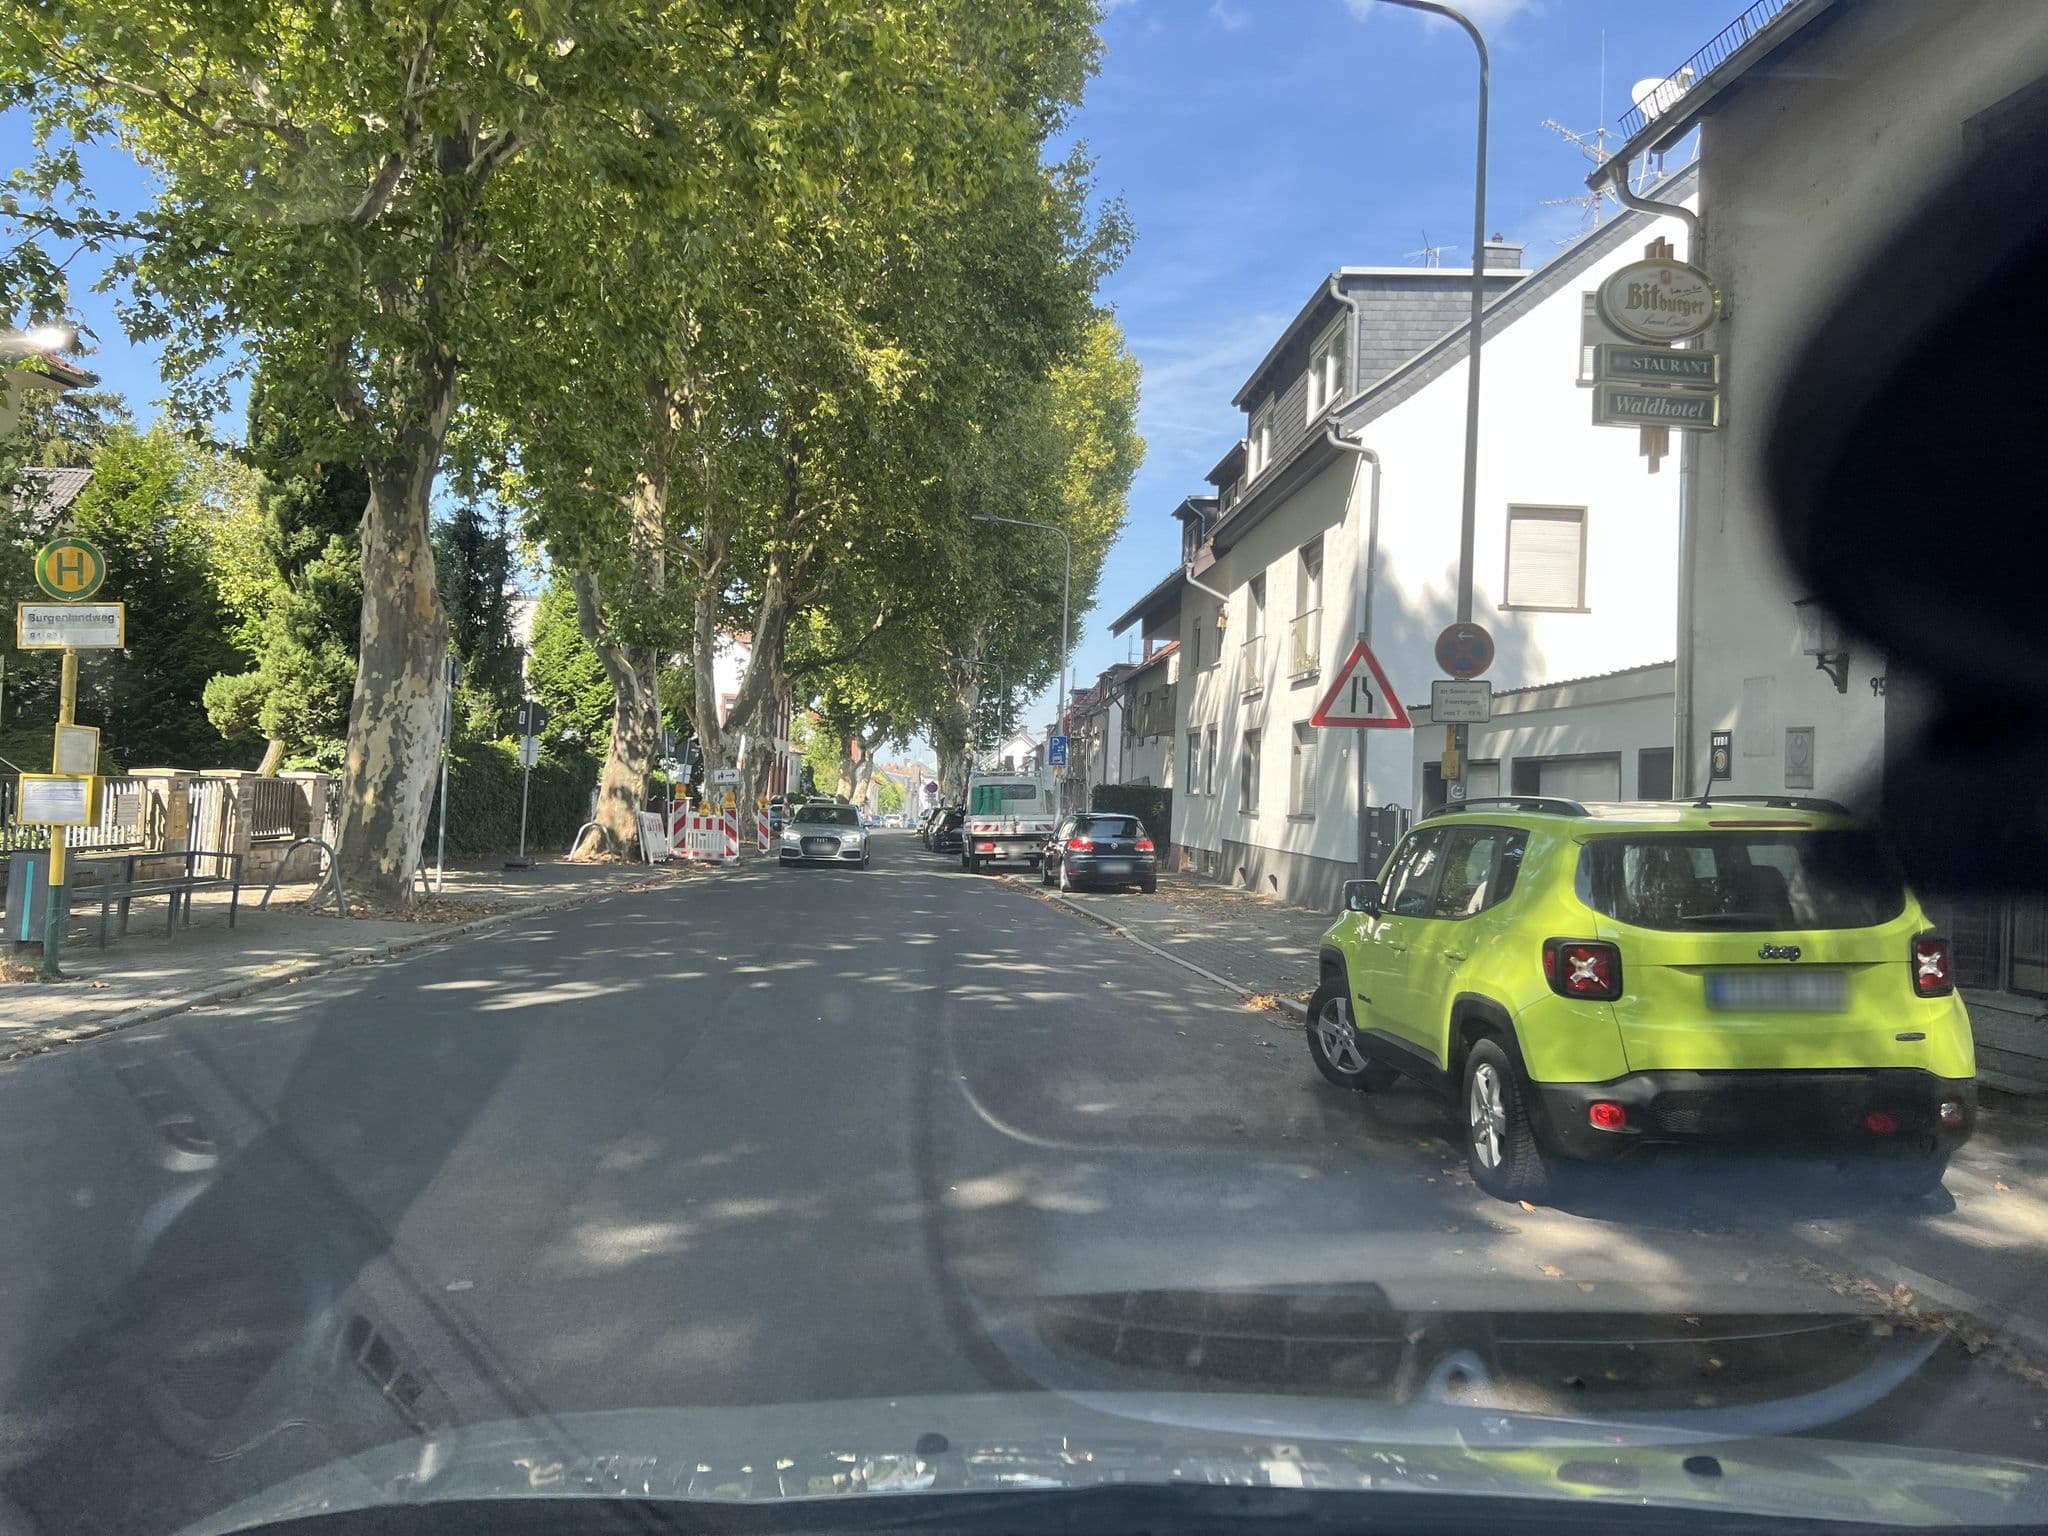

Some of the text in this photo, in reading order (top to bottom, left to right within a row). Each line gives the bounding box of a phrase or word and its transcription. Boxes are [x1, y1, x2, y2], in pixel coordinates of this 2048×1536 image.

[1625, 282, 1705, 316] Bitburger
[1616, 356, 1708, 374] STAURANT
[1616, 395, 1705, 417] Waldhotel
[56, 552, 84, 586] H
[1052, 738, 1059, 749] P
[1758, 943, 1802, 962] Jeep
